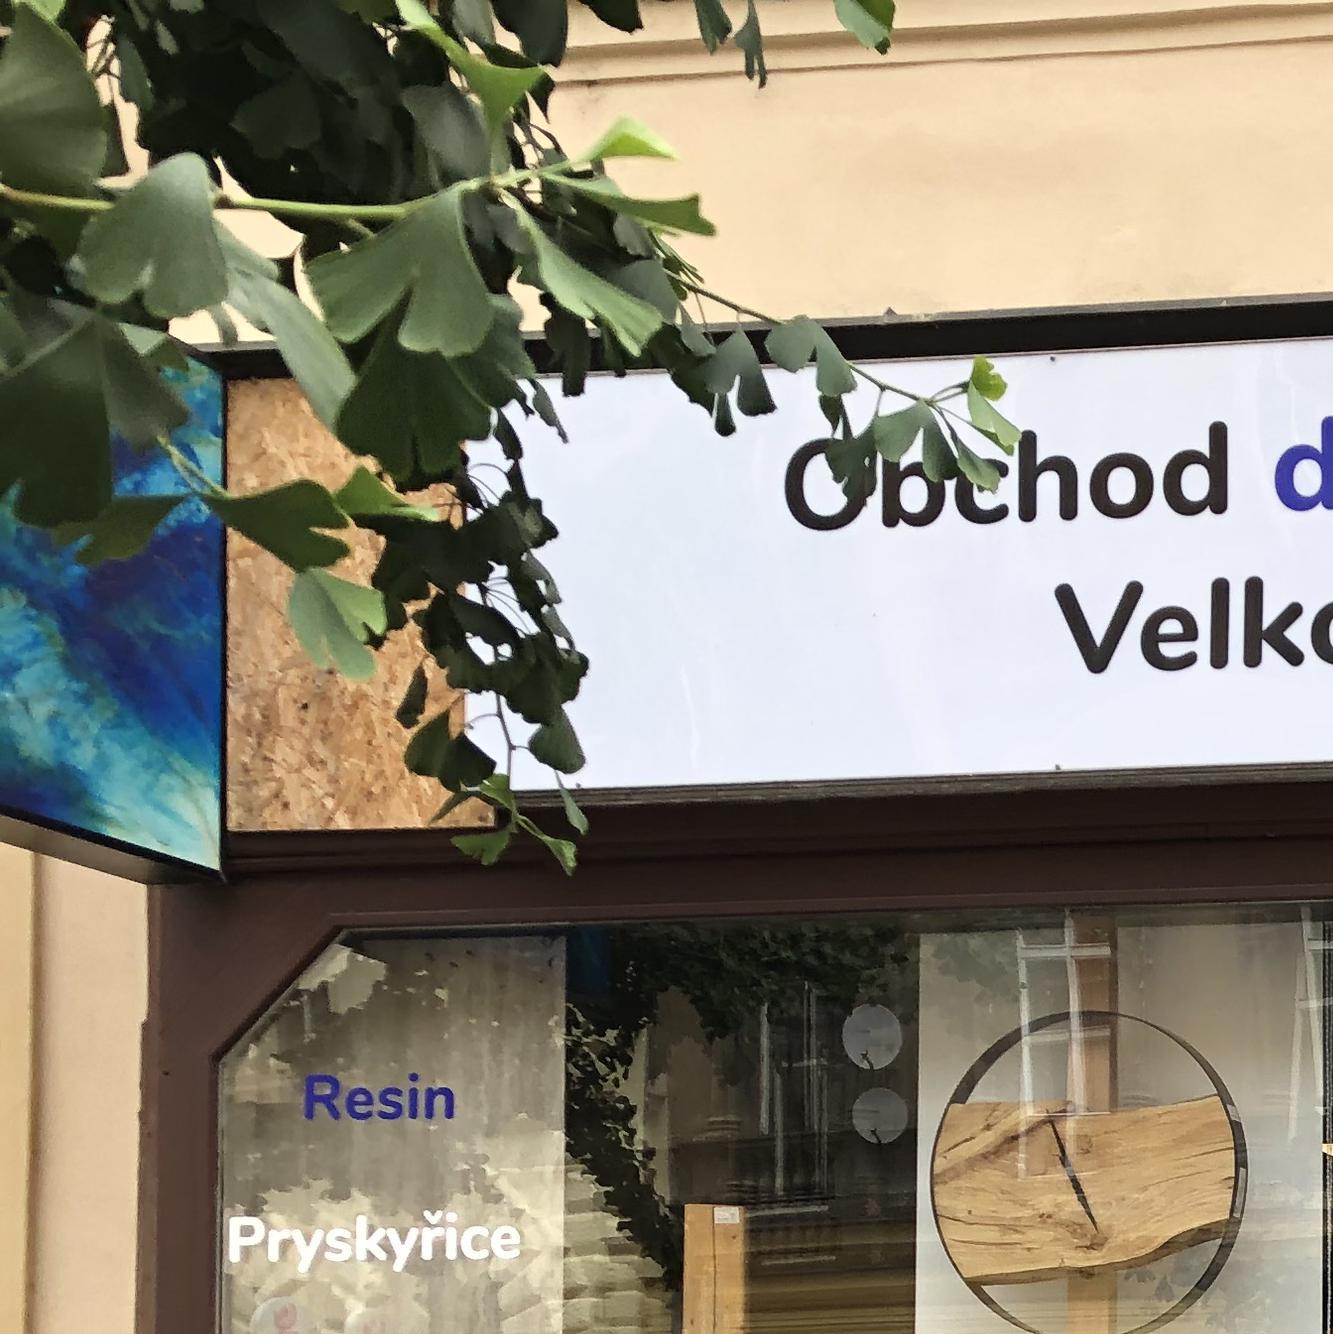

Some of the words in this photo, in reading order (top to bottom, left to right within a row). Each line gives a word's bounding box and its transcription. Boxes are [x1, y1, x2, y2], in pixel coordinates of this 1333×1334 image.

[784, 420, 1229, 531] Obchod
[304, 1072, 456, 1122] Resin
[227, 1209, 522, 1274] Pryskyřice
